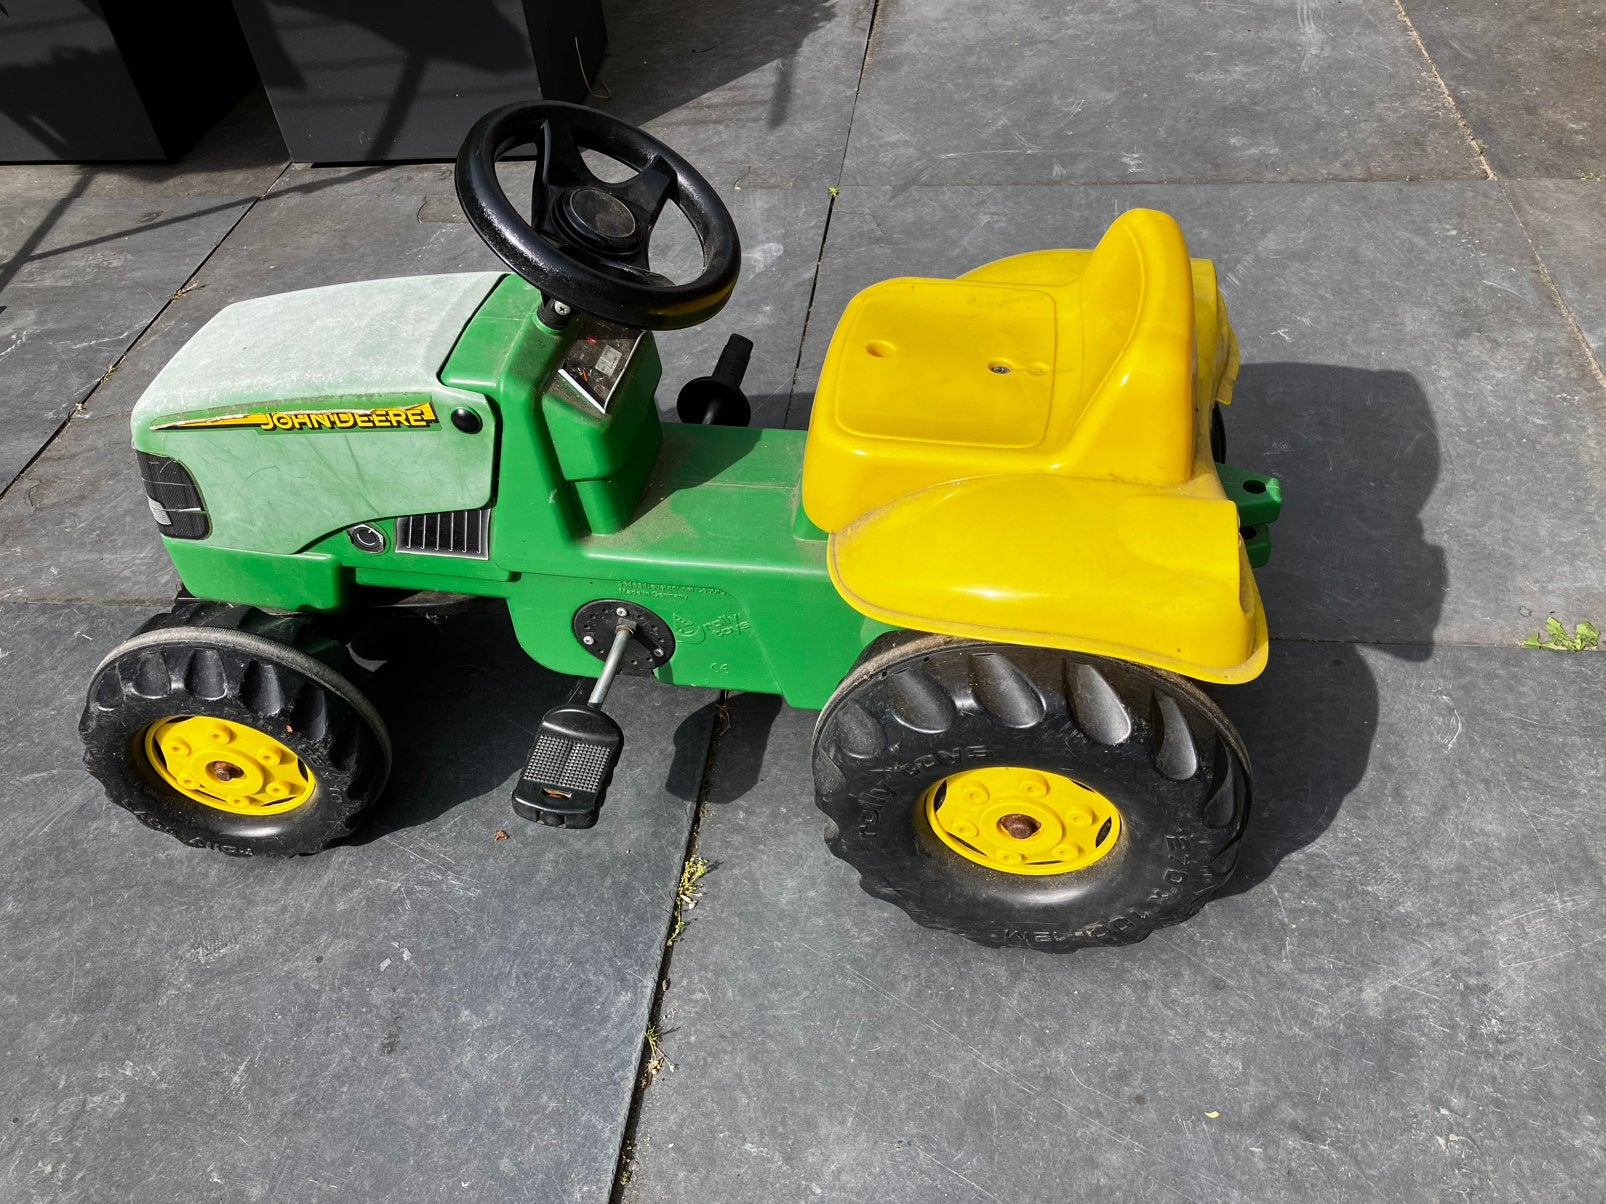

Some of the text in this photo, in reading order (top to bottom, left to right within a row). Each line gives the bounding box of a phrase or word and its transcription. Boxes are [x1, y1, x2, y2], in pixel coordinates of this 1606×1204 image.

[260, 409, 427, 431] JOHN DEERE
[618, 588, 641, 596] Made
[642, 589, 650, 597] in
[651, 590, 688, 600] Germany
[704, 612, 739, 631] rolly
